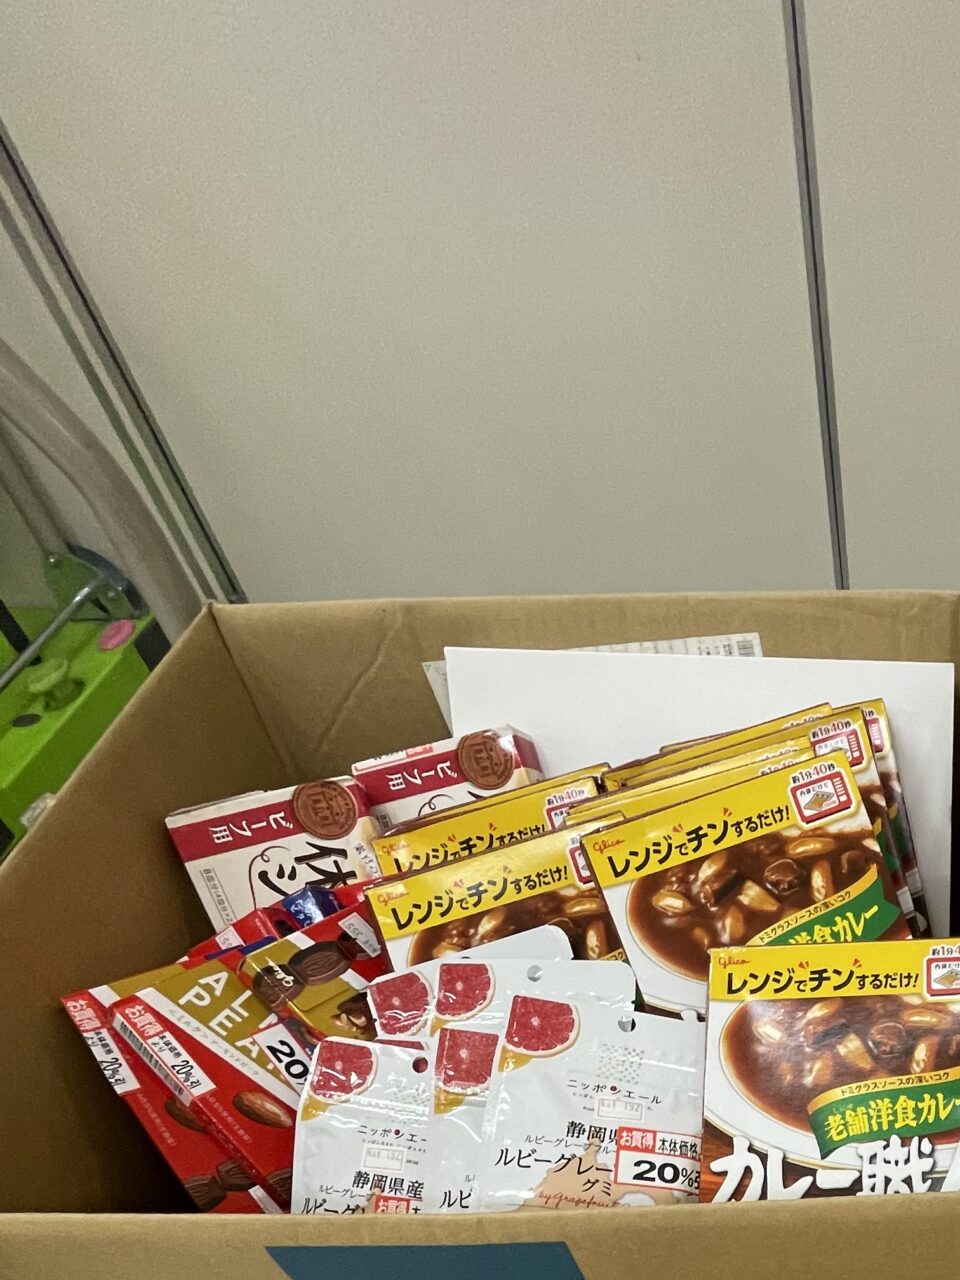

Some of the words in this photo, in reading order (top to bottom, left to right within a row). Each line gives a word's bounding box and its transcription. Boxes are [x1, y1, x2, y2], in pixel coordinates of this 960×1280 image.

[386, 760, 458, 792] ビーフ用
[208, 810, 295, 845] ビーフ用
[606, 804, 791, 880] レンジでチンするだけ!
[390, 864, 569, 931] レンジでチンするだけ!
[726, 966, 920, 995] レンジでチンするだけ!
[125, 1004, 161, 1039] お買得
[177, 986, 276, 1071] PEA
[840, 1070, 950, 1097] ドミグラスソースの深いコク
[619, 1130, 655, 1150] お買得
[351, 1170, 425, 1200] 静岡県産
[582, 1178, 613, 1197] グミ
